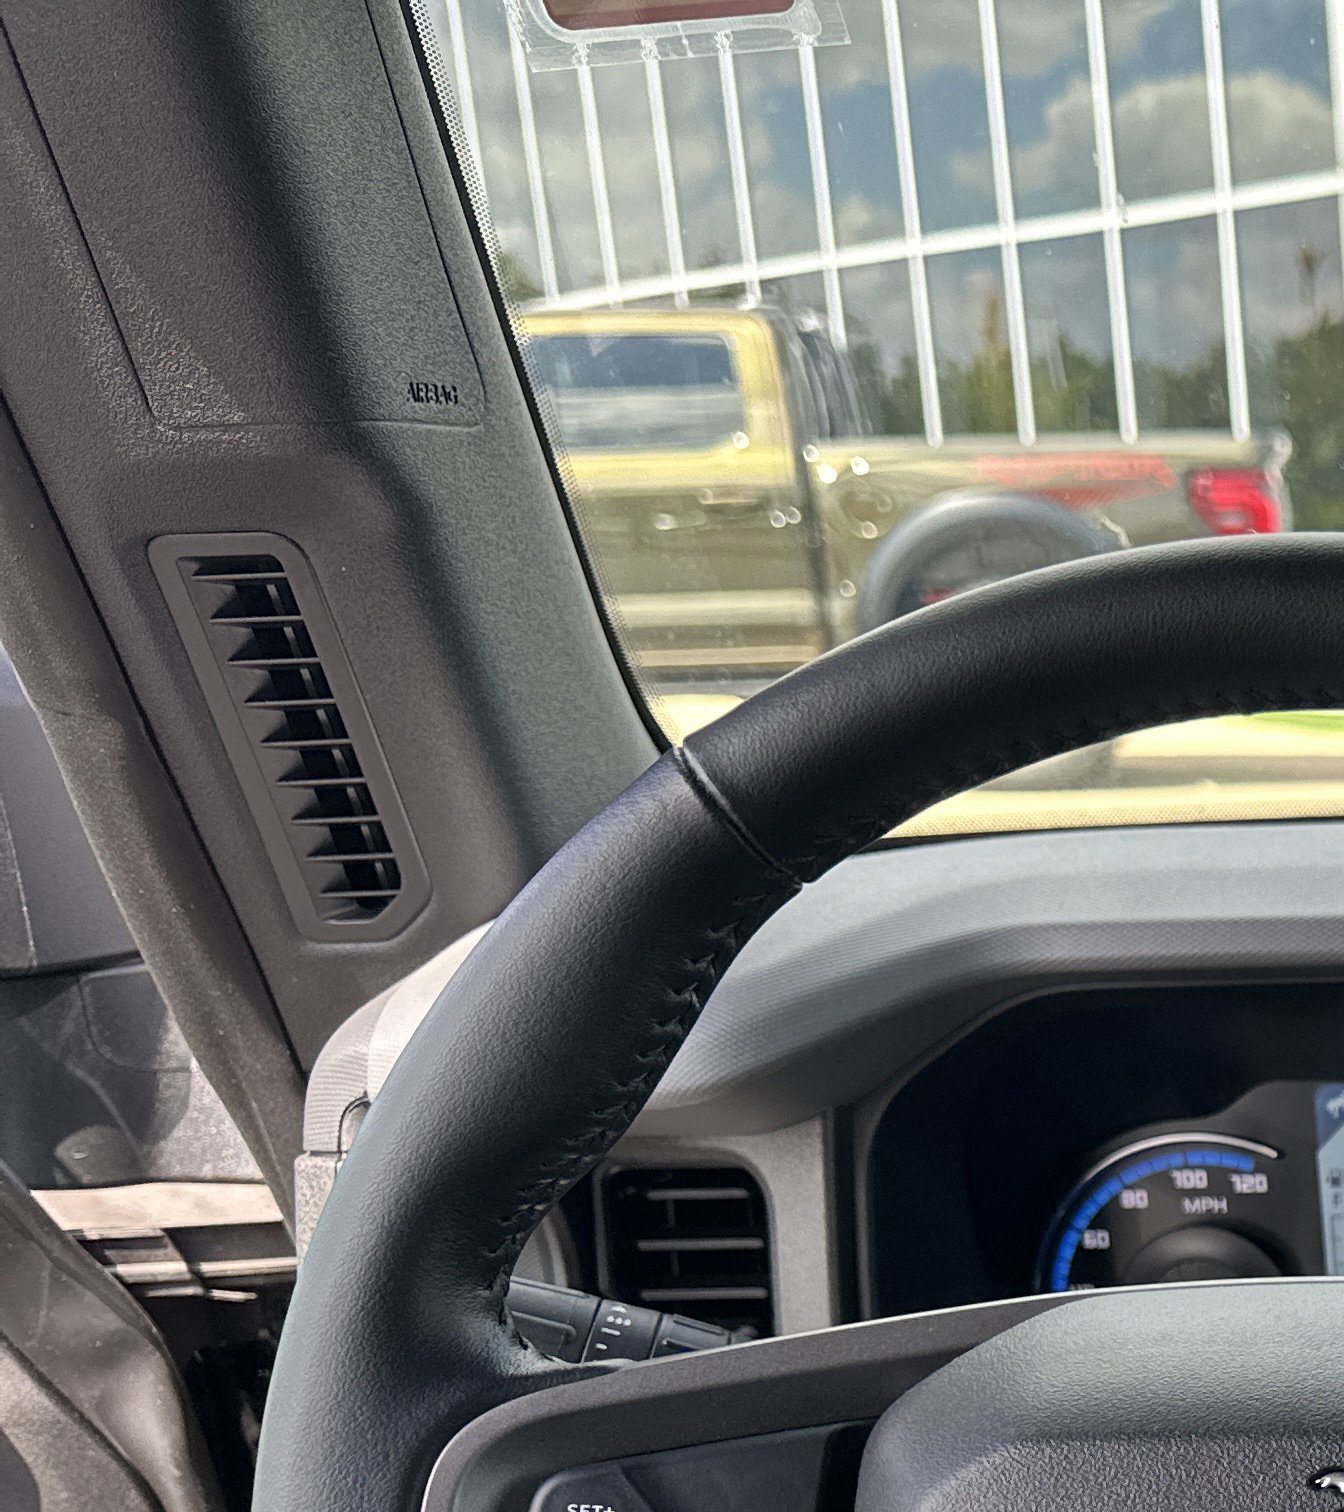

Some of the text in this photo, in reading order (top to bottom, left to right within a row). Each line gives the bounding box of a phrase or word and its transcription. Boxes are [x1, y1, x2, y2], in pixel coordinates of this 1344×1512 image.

[406, 381, 459, 405] AIRBAG
[1171, 1168, 1208, 1190] 100
[1230, 1172, 1269, 1194] 120
[1183, 1196, 1228, 1215] MPH
